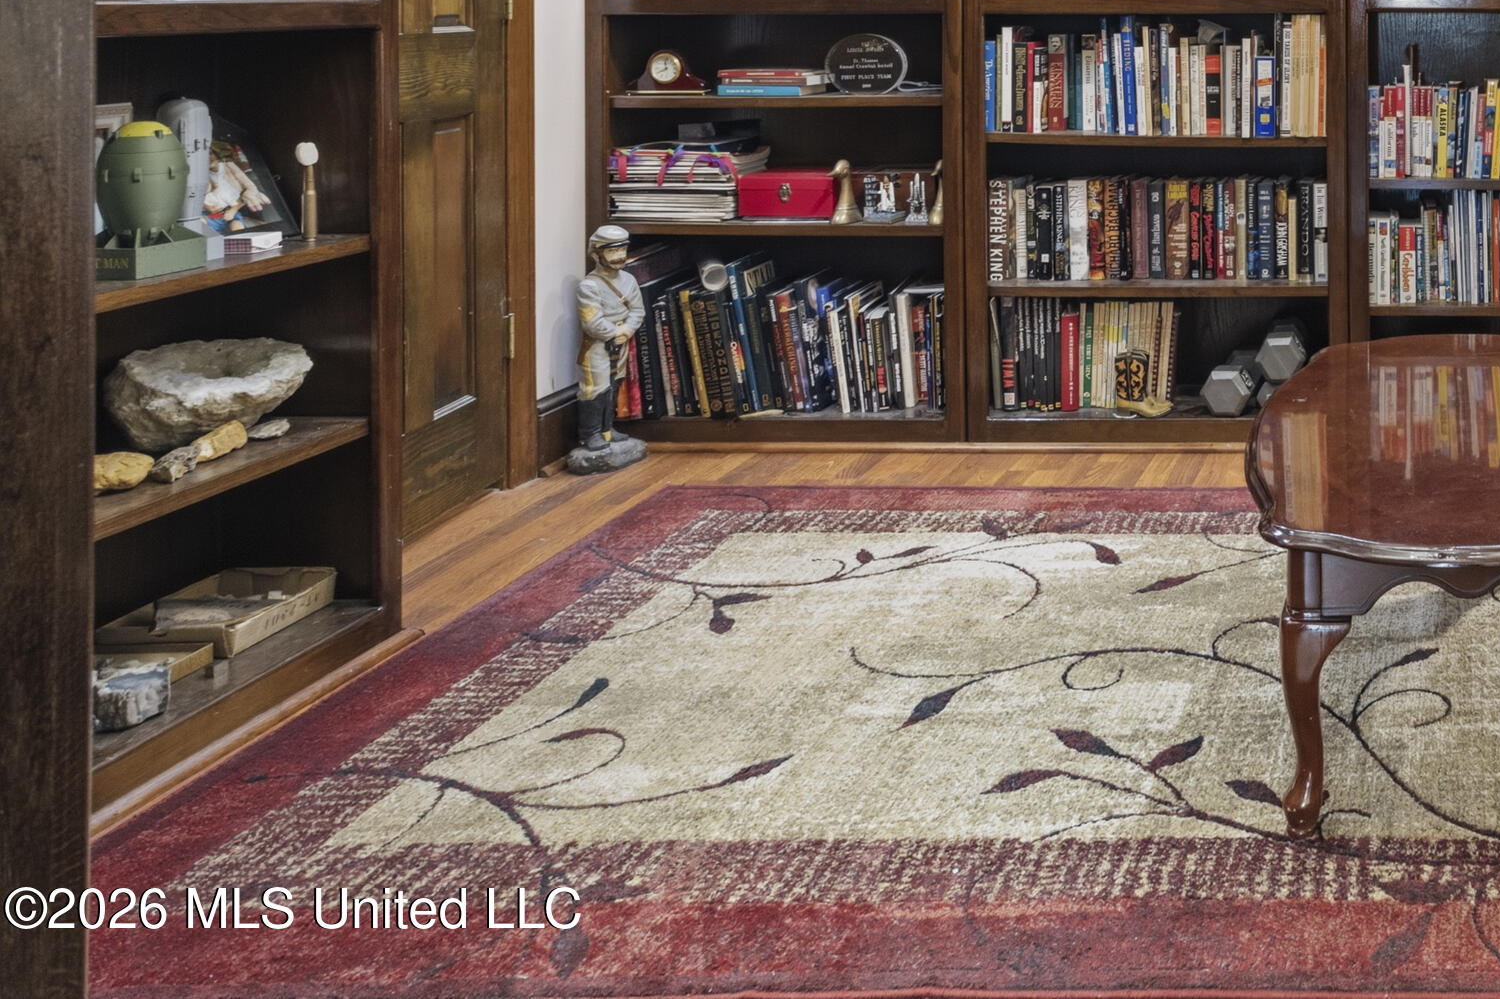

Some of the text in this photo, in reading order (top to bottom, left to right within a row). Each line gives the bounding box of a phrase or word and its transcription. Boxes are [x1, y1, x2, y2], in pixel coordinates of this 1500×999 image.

[1124, 40, 1132, 72] BIRDING
[1386, 123, 1394, 157] California
[1440, 107, 1448, 137] ALASKA
[990, 179, 1003, 281] STEPHEN KING
[1301, 186, 1309, 256] BRANDO
[1107, 227, 1120, 280] RICHARD
[1276, 222, 1287, 267] JOHN GRISHAM
[101, 257, 129, 270] MAN
[1402, 252, 1415, 293] Caribbean
[1004, 357, 1015, 388] WWII
